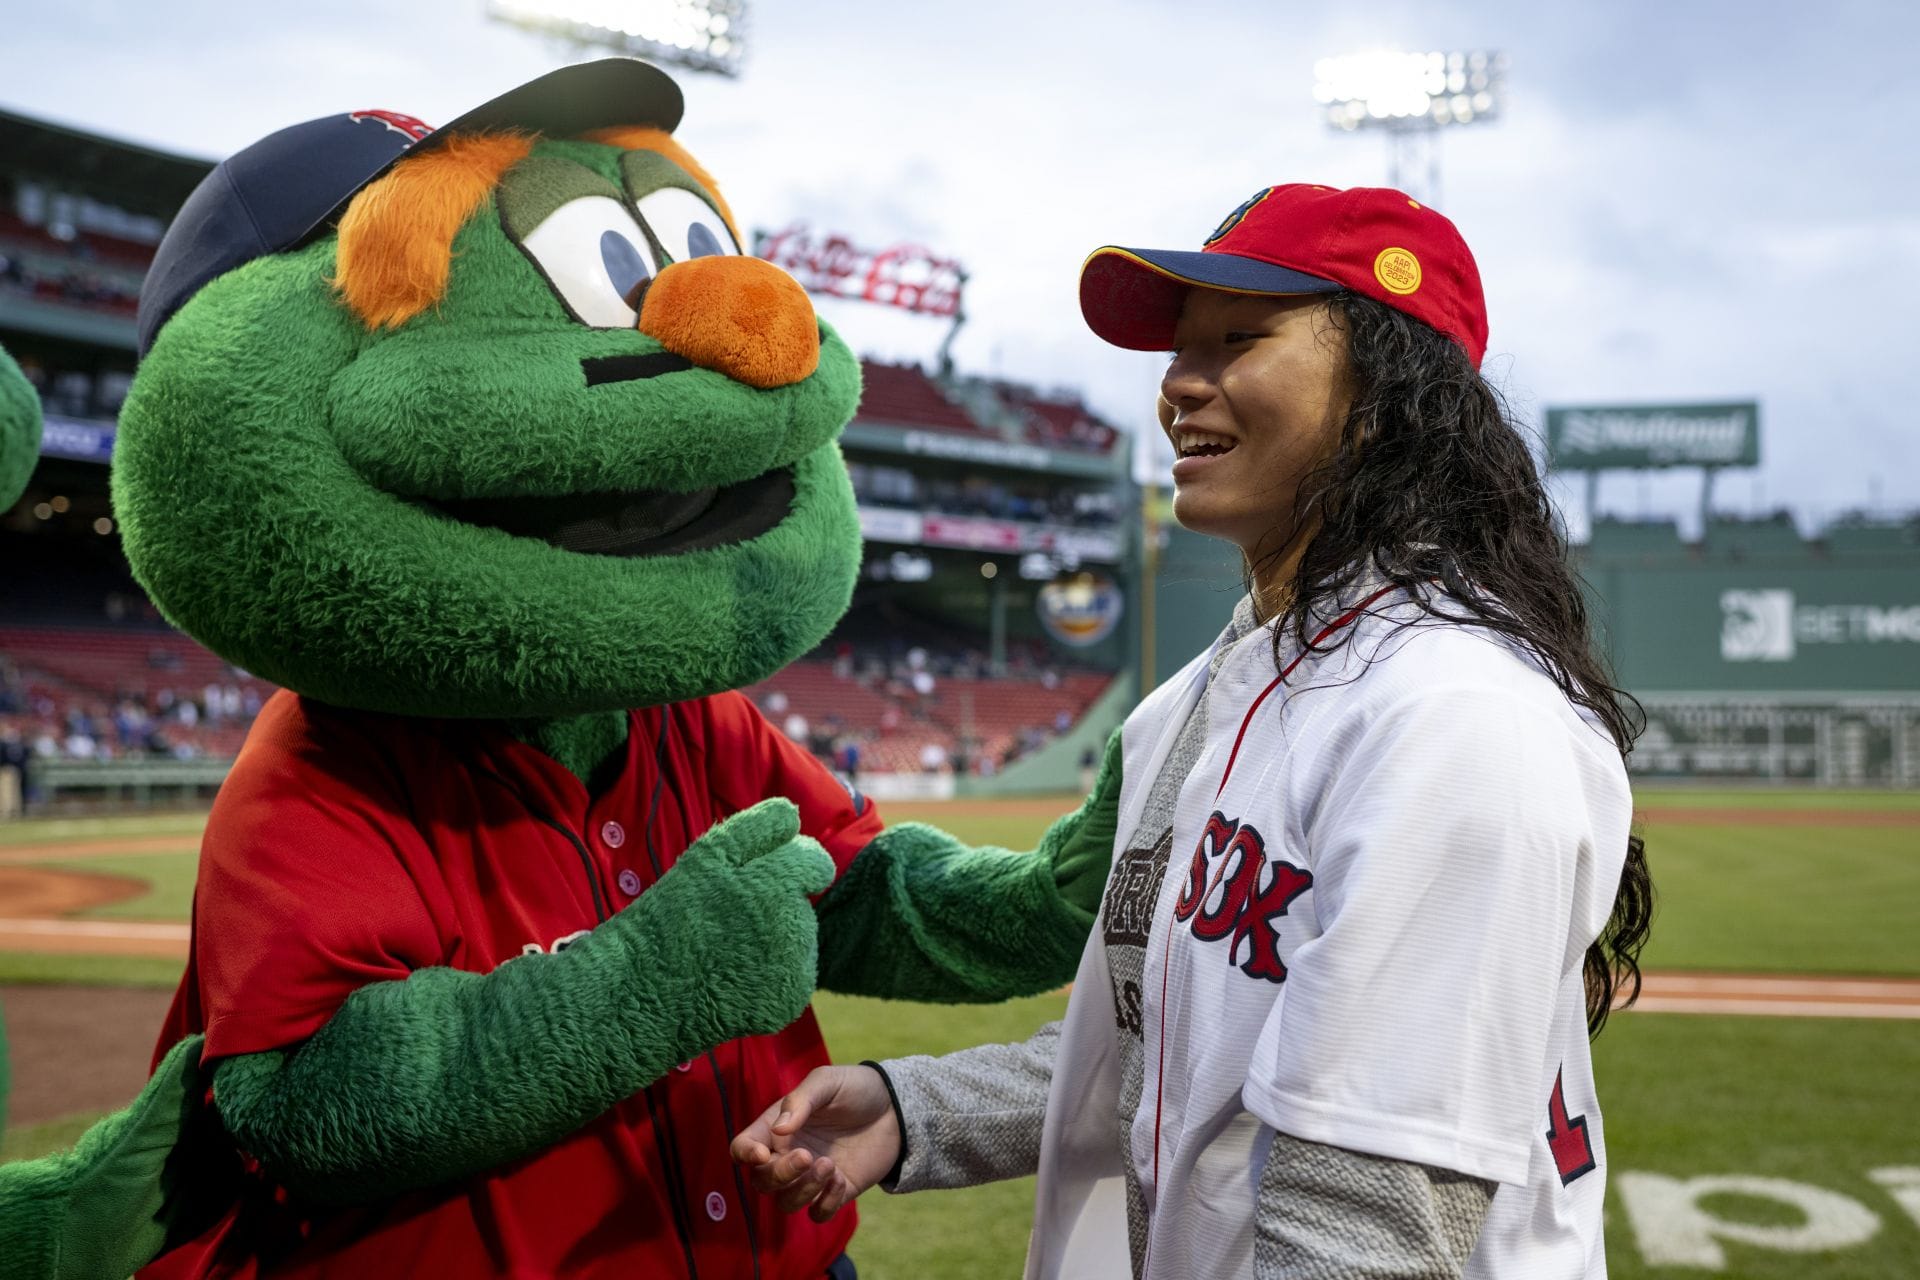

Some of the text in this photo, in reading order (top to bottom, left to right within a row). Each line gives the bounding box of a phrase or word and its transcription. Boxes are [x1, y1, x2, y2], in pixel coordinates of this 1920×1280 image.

[1394, 256, 1410, 270] AAPI
[1386, 270, 1409, 285] 2023
[1175, 810, 1313, 984] SOX
